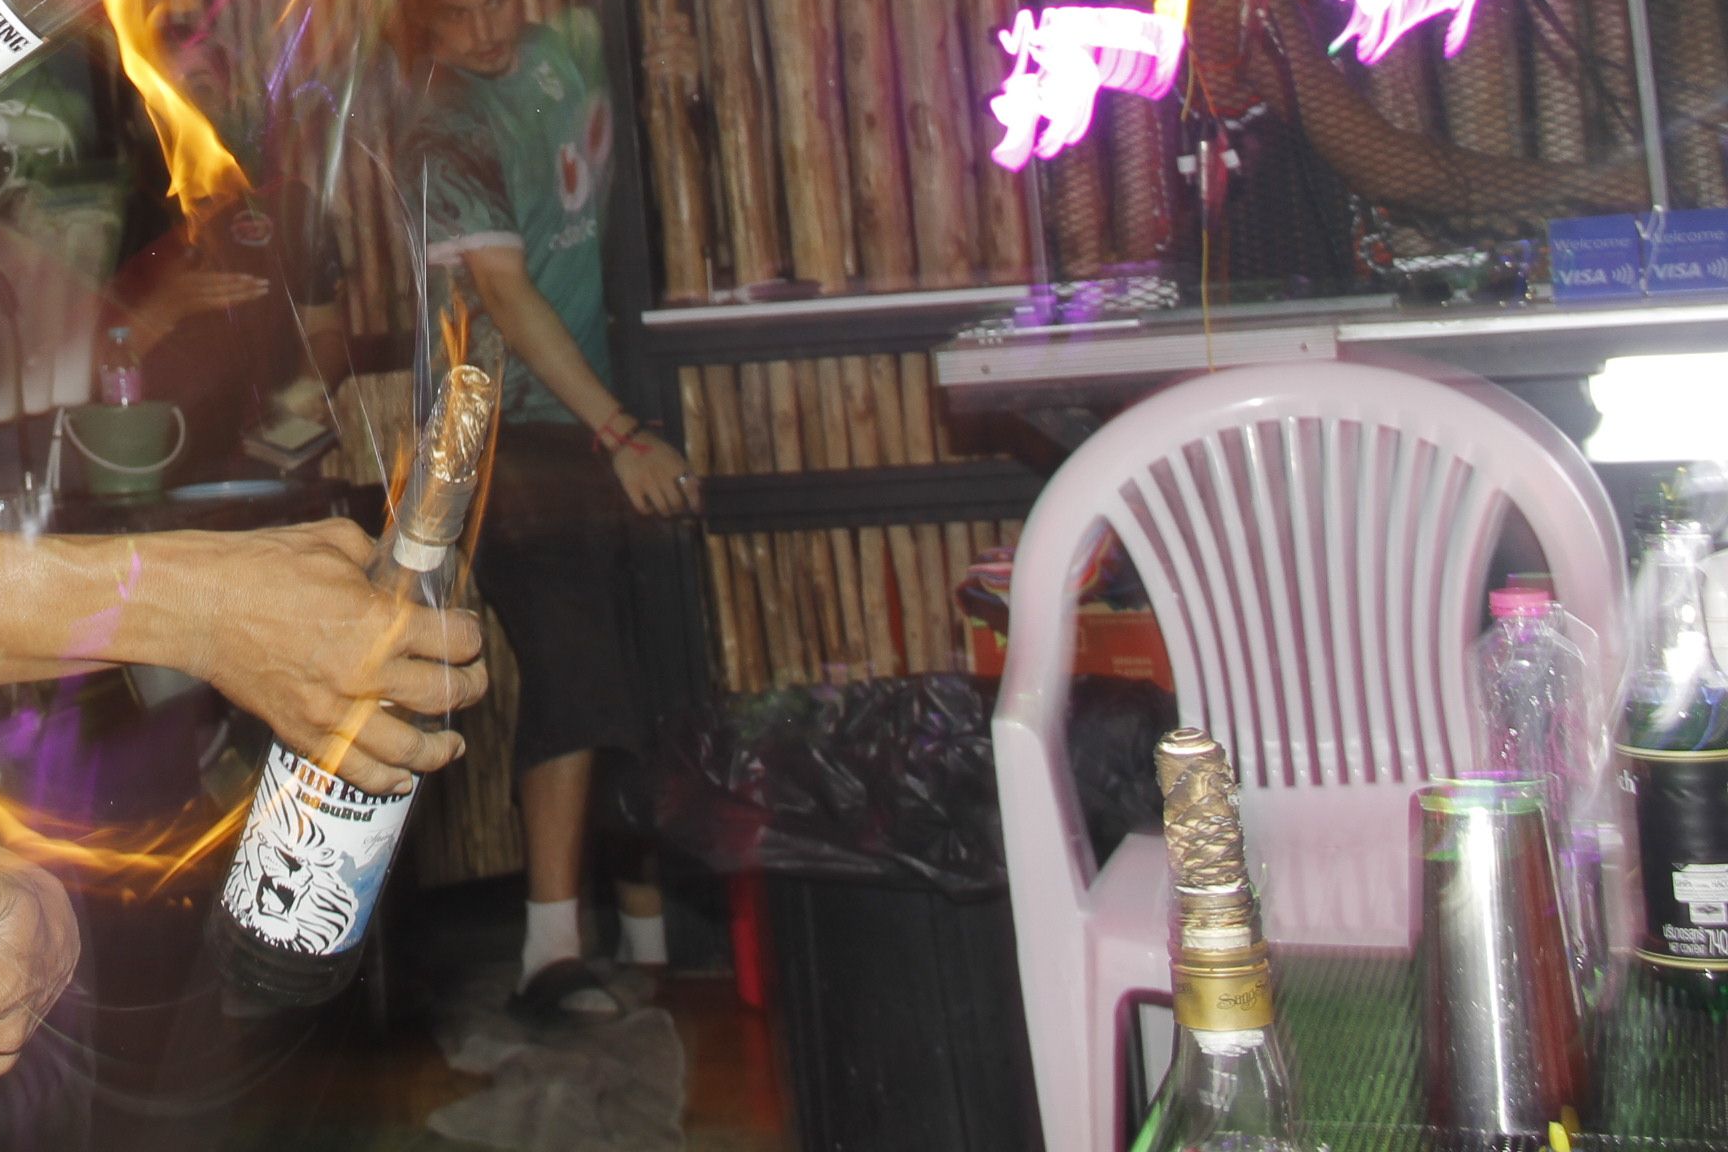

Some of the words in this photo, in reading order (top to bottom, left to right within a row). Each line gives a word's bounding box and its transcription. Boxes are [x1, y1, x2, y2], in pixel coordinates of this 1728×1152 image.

[1554, 237, 1632, 250] Welcome
[1559, 268, 1608, 285] VISA
[1652, 261, 1703, 279] VISA
